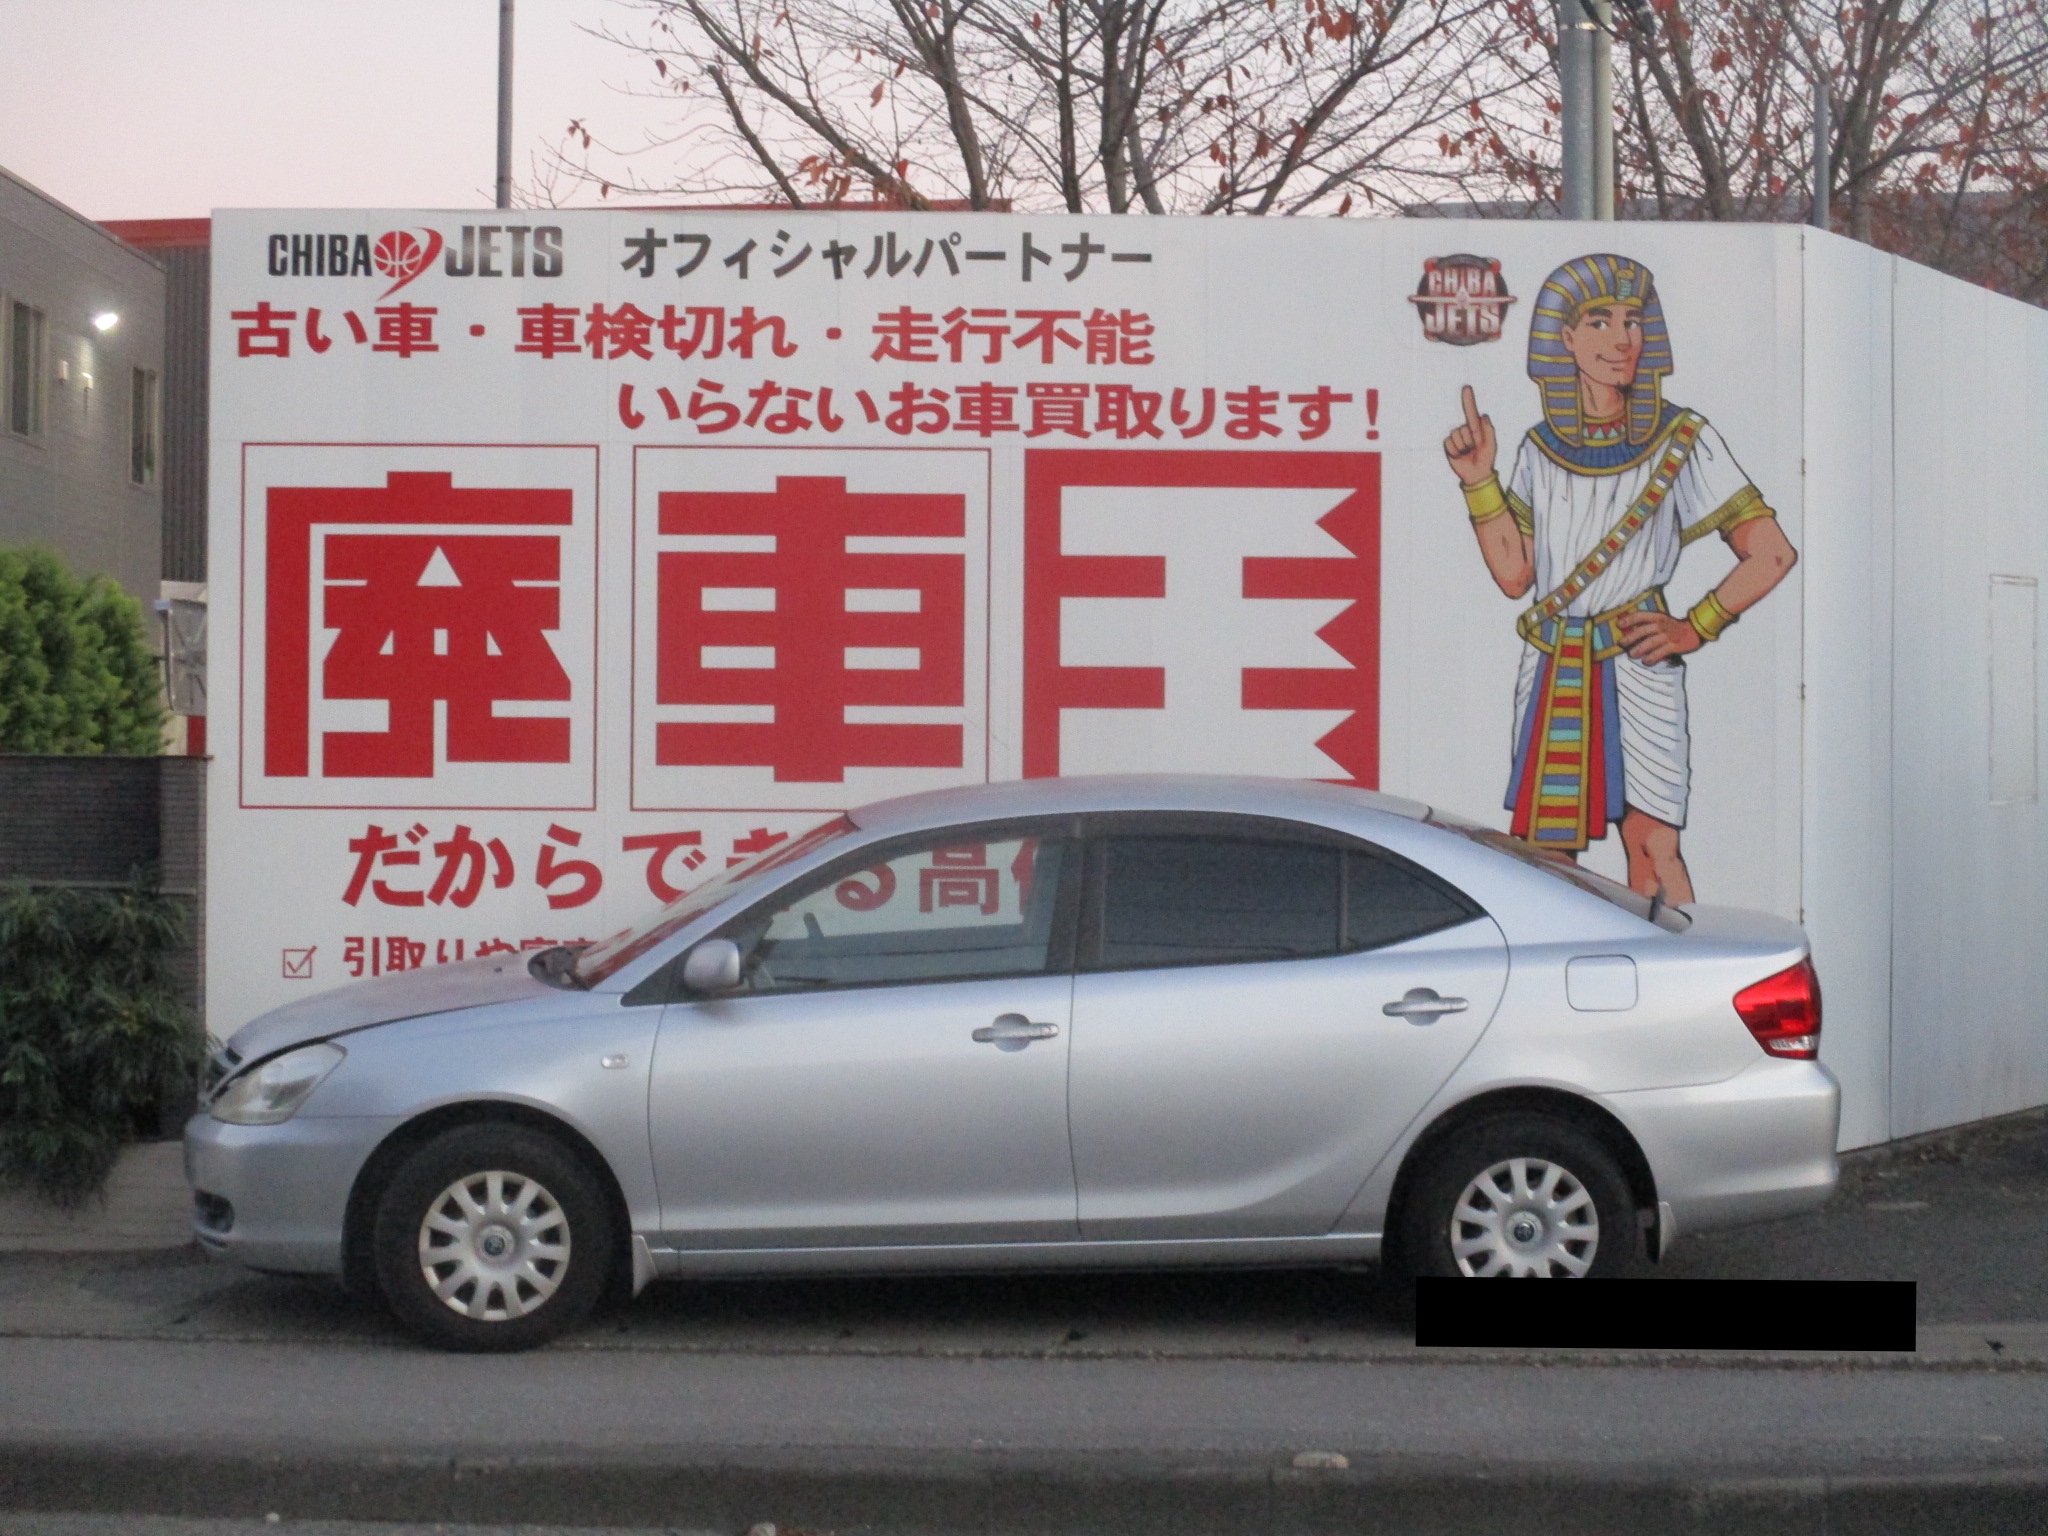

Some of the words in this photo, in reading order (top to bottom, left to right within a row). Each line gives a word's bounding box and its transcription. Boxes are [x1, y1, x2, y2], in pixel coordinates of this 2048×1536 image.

[269, 234, 371, 277] CHIBA
[445, 225, 563, 278] JETS
[621, 228, 1153, 281] オフィシャルパートナー
[1427, 266, 1496, 297] CHIBA
[1425, 302, 1500, 336] JETS
